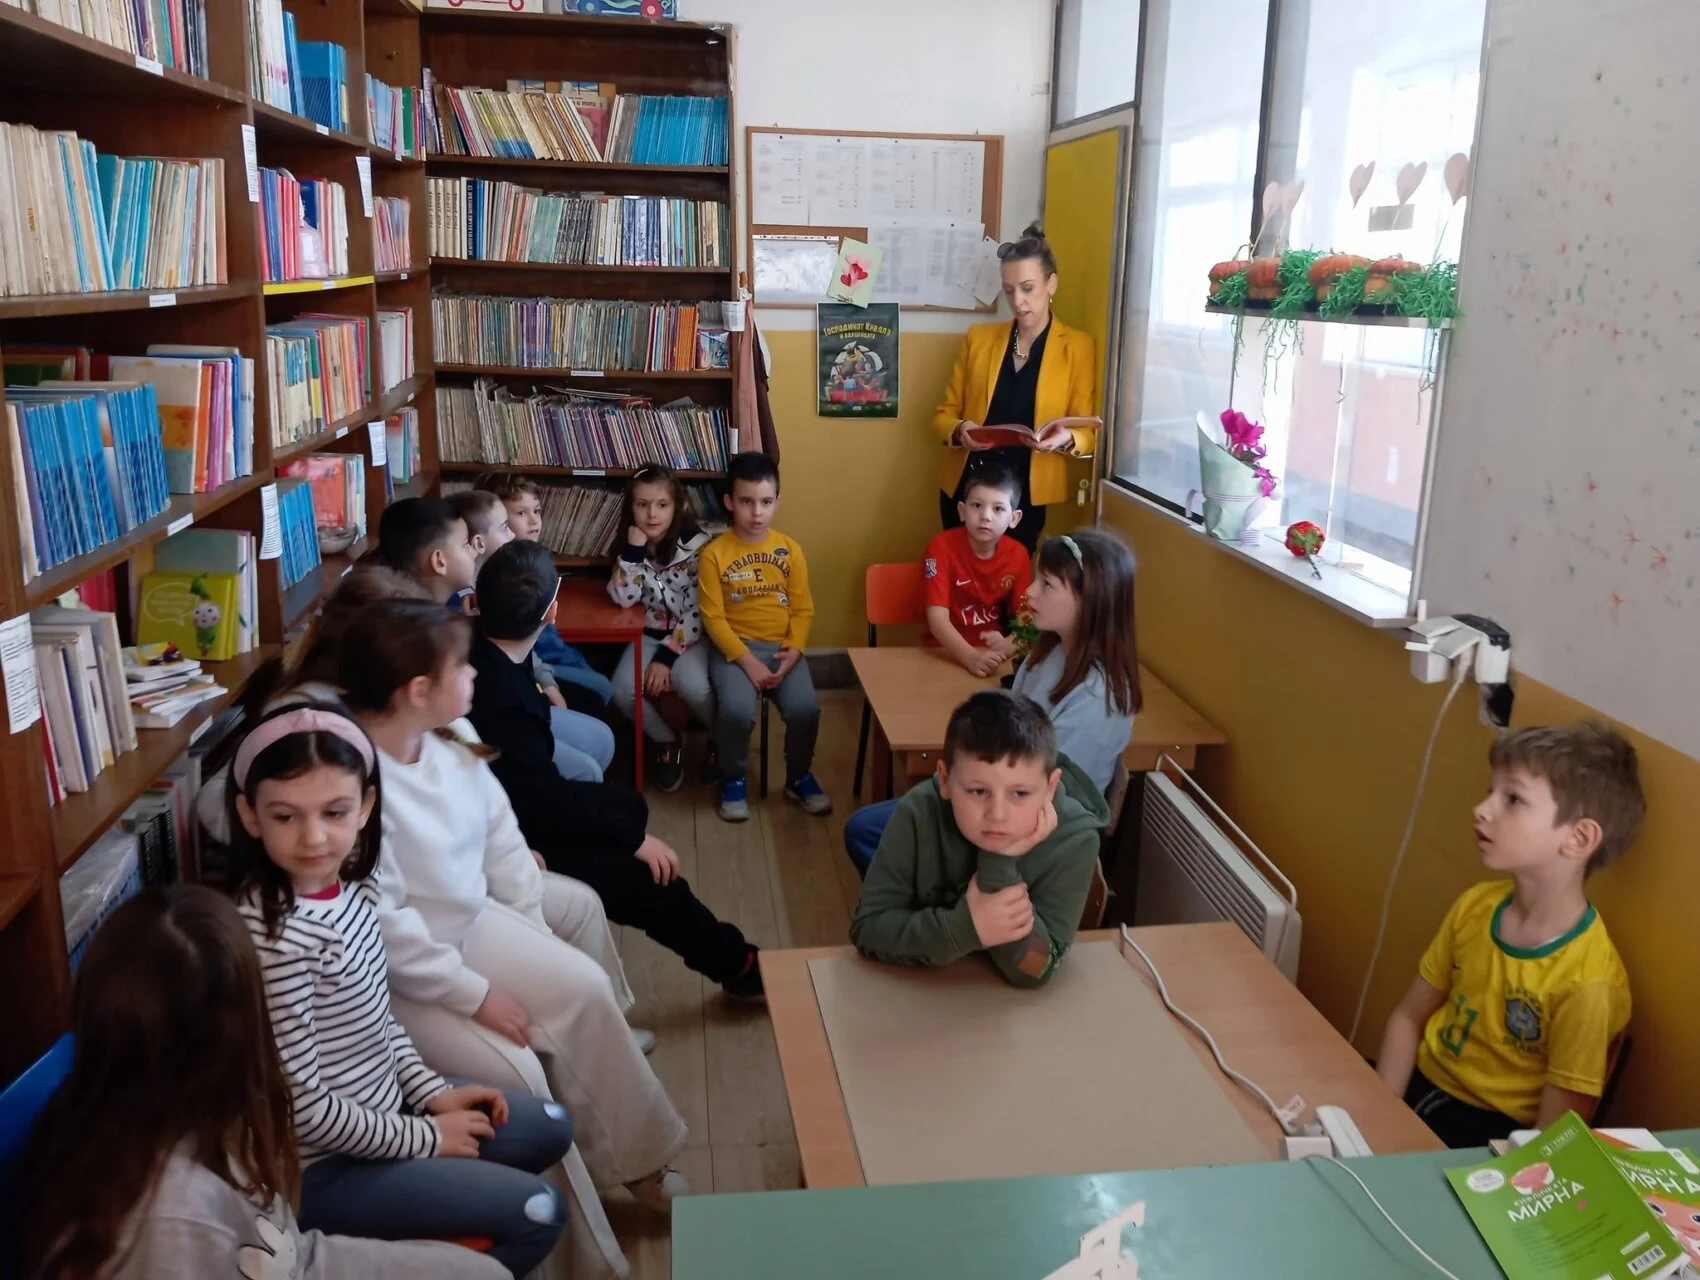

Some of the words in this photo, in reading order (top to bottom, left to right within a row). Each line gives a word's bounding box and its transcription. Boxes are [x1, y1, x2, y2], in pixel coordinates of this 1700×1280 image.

[753, 568, 763, 582] E
[1618, 1166, 1700, 1194] ИРНА
[1507, 1181, 1585, 1223] МИРНА
